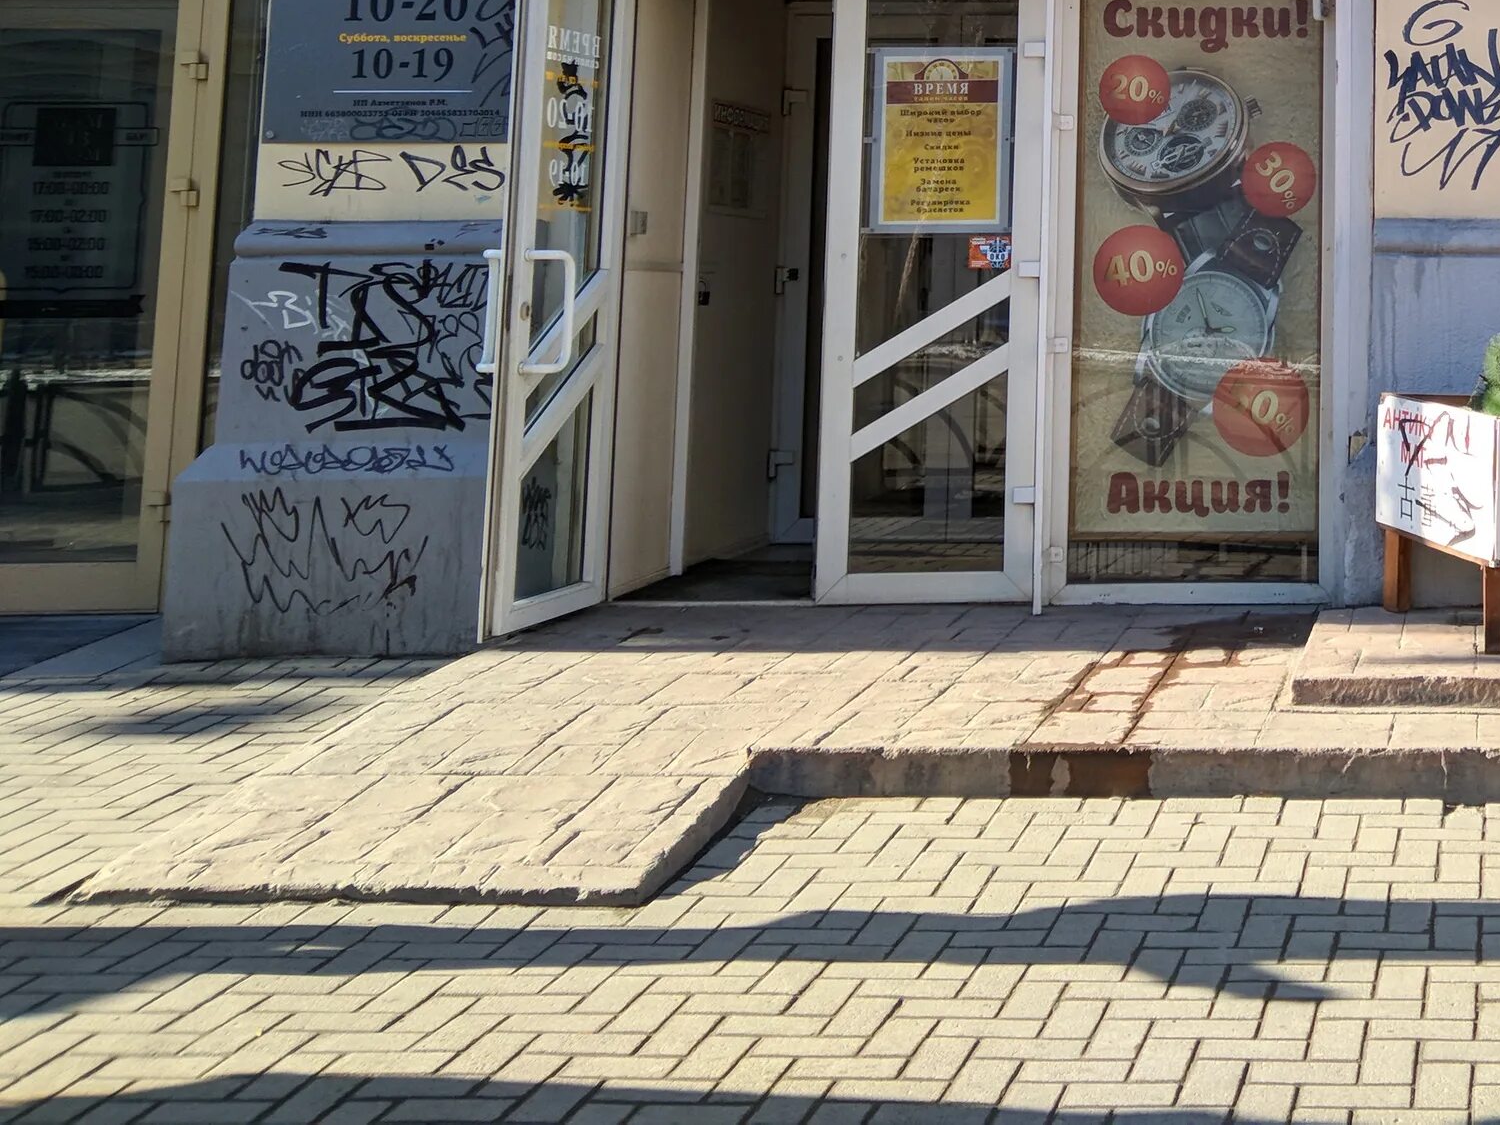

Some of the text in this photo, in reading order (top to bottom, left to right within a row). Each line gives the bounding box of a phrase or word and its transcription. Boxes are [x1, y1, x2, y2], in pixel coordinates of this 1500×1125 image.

[338, 32, 468, 44] Суббота, воскресенье
[351, 47, 454, 83] 10-19
[913, 82, 969, 95] ВРЕМЯ
[1110, 74, 1164, 105] 20%
[900, 109, 947, 118] Широкий
[1254, 150, 1296, 210] 30%
[1104, 250, 1178, 287] 40%
[1106, 471, 1291, 518] Акция!
